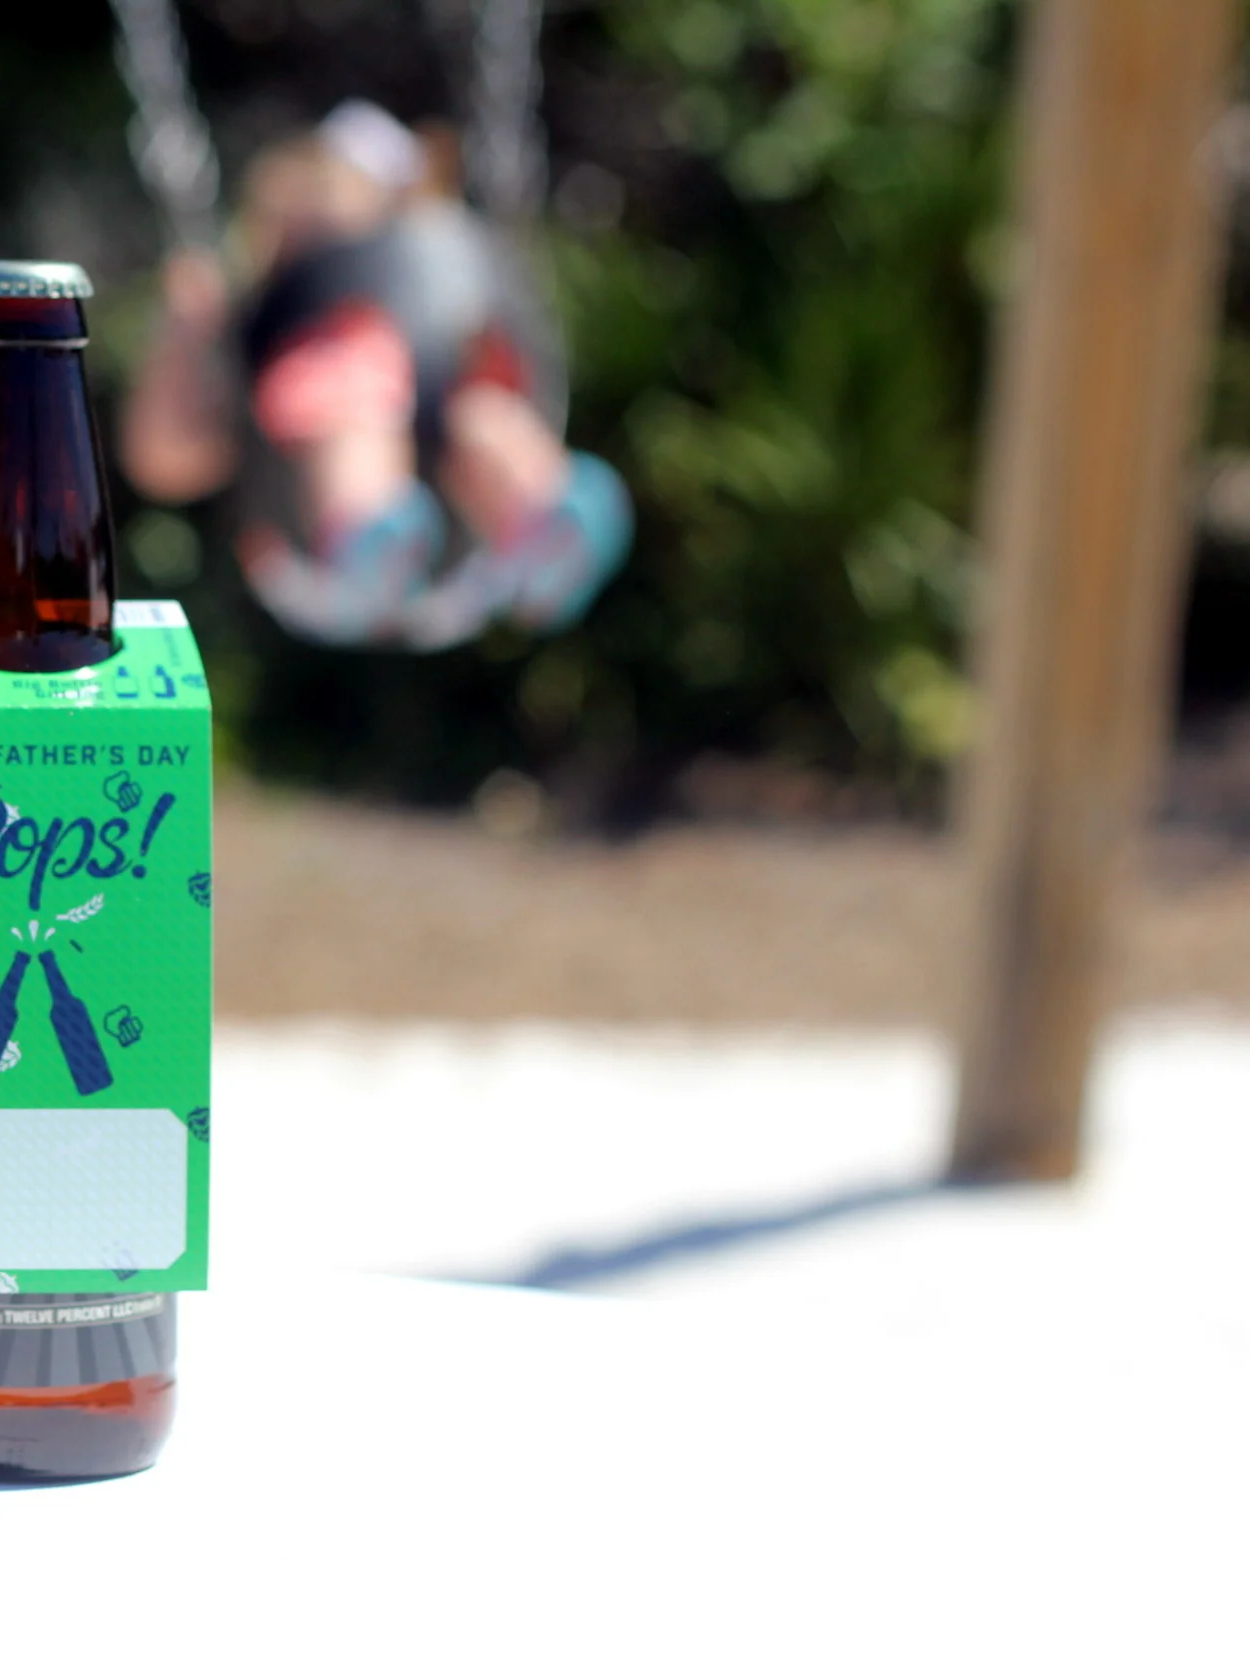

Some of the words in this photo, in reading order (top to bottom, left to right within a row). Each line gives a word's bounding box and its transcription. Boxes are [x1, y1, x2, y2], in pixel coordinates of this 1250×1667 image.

[138, 744, 190, 766] DAY
[5, 1309, 54, 1324] TWELVE
[57, 1305, 111, 1323] PERCENT
